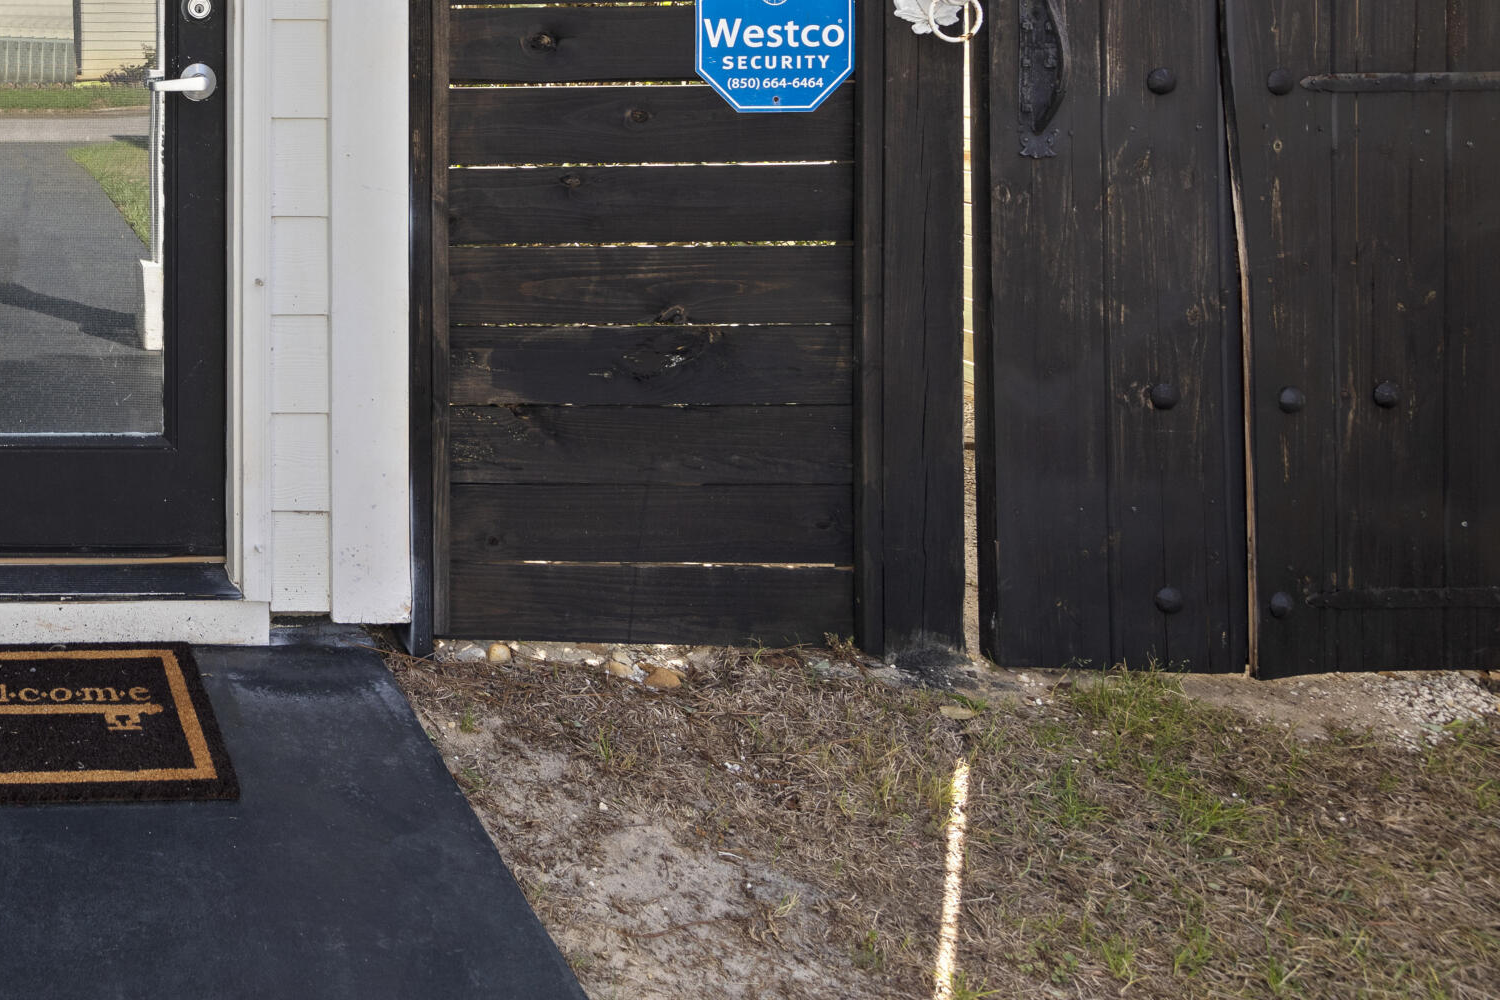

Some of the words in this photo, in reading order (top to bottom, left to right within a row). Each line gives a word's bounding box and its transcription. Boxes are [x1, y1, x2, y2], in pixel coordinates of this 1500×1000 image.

[703, 17, 845, 48] Westco
[722, 55, 830, 70] SECURITY
[727, 77, 760, 90] (850)
[762, 77, 824, 89] 664-6464
